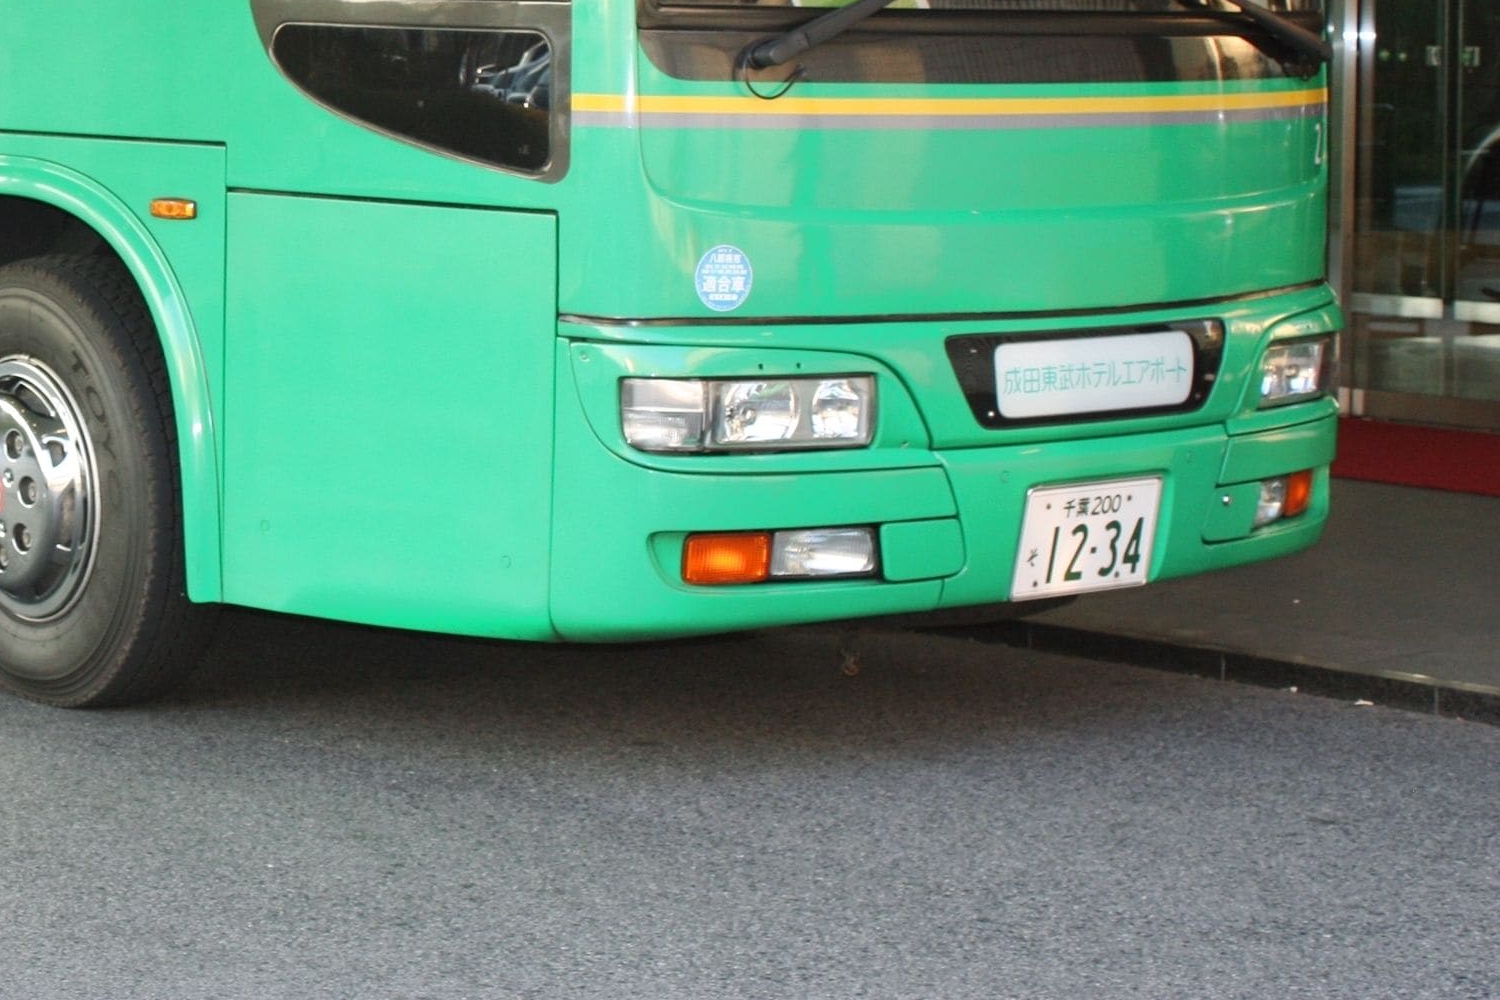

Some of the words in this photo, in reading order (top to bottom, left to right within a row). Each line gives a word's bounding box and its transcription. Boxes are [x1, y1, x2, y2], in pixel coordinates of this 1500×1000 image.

[1004, 356, 1188, 396] 成田東武ホテルエアポート
